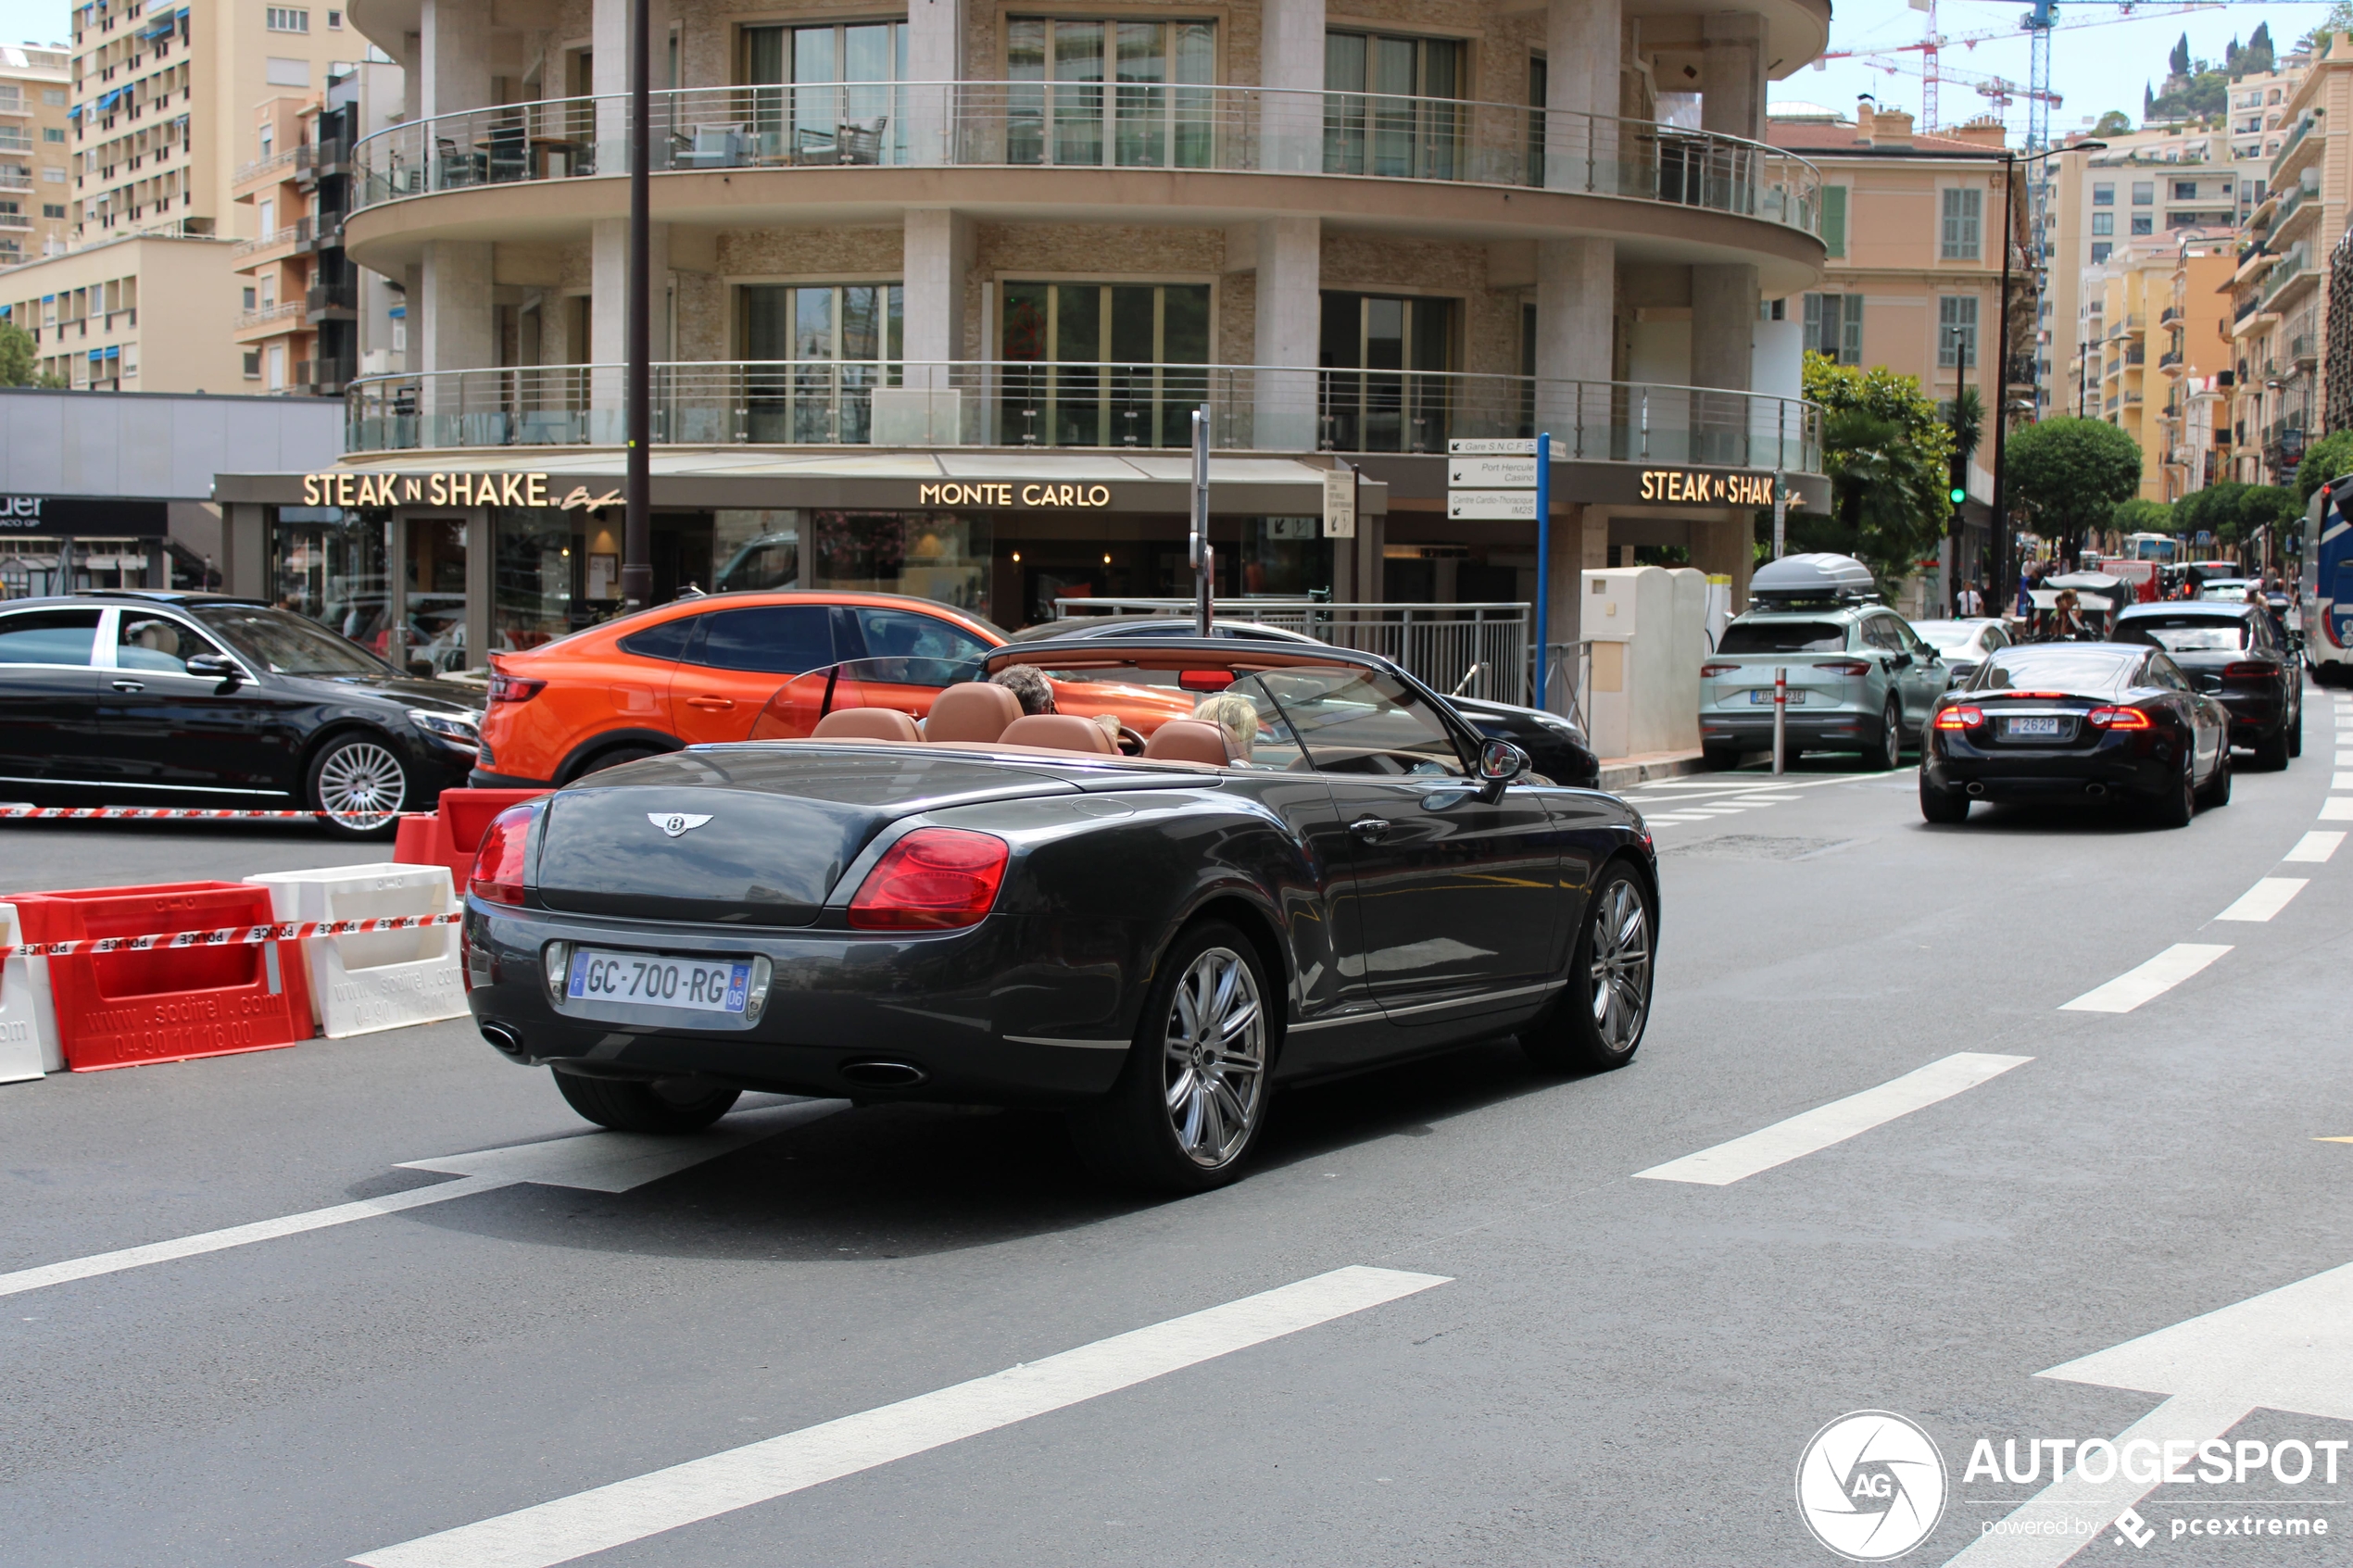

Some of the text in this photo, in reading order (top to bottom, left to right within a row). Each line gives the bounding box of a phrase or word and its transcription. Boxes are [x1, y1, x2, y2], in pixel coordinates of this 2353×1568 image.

[1465, 443, 1486, 451] Gare
[1481, 463, 1534, 471] Port Hercule
[1504, 473, 1534, 482] Casino
[304, 473, 398, 507] STEAK
[405, 479, 422, 501] N
[429, 472, 548, 508] SHAKE
[920, 483, 1110, 507] MONTE CARLO
[1641, 470, 1711, 502] STEAK
[1714, 479, 1725, 498] N
[1727, 474, 1773, 506] SHAK
[1453, 495, 1474, 505] Centre
[2023, 719, 2055, 731] 262P
[112, 809, 149, 817] POLICE
[19, 943, 68, 956] POLICE
[102, 935, 147, 950] POLICE
[180, 931, 224, 945] POLICE
[254, 925, 294, 940] POLICE
[320, 922, 356, 935] POLICE
[381, 917, 415, 929] POLICE
[587, 960, 725, 1003] GC-700-RG
[727, 990, 744, 1006] 06
[114, 1021, 252, 1060] 04 90 11 16 00
